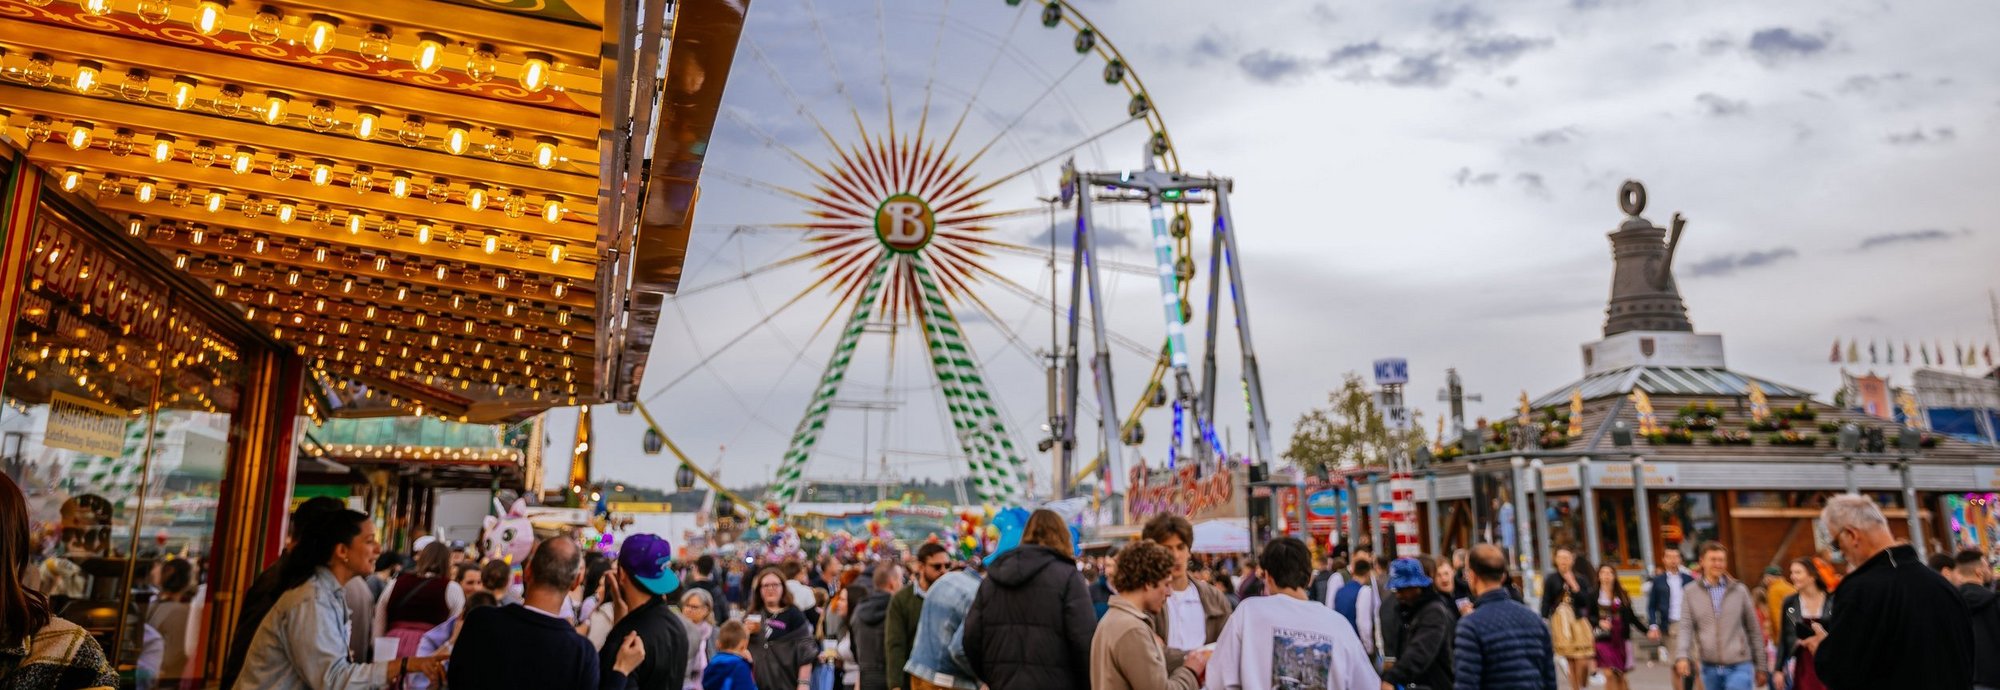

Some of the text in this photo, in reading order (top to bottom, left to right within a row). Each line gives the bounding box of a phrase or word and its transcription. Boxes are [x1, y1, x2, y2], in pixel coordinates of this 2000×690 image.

[884, 202, 926, 244] B
[1375, 361, 1390, 379] WC
[1391, 361, 1407, 378] WC
[1389, 408, 1405, 421] WC
